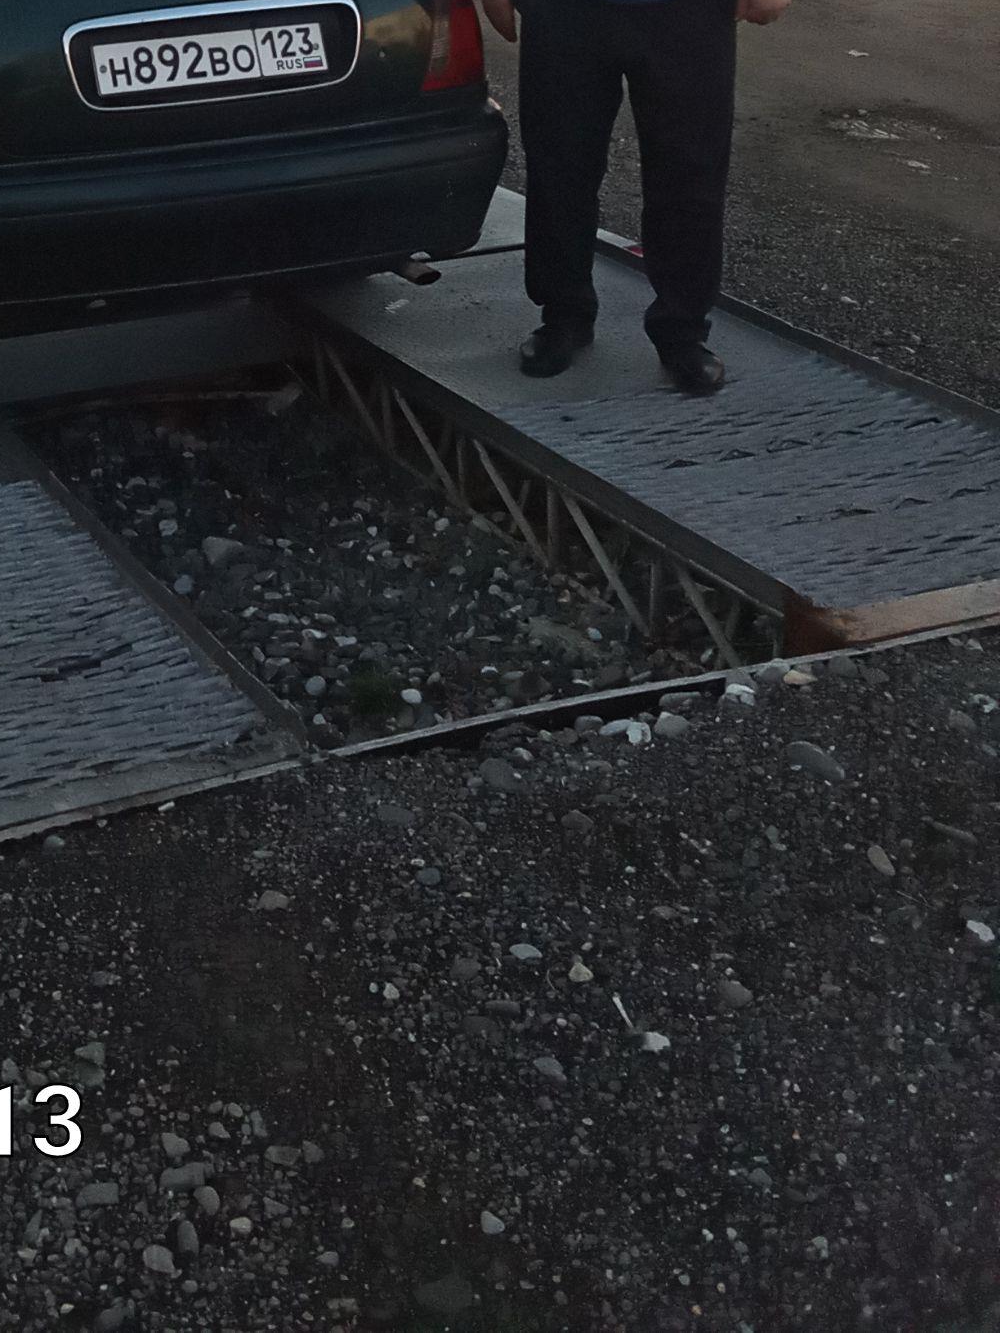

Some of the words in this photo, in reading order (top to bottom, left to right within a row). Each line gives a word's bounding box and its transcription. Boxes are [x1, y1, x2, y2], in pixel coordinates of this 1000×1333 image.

[108, 41, 255, 88] Н892ВО
[261, 27, 314, 59] 123
[277, 58, 303, 71] RUS
